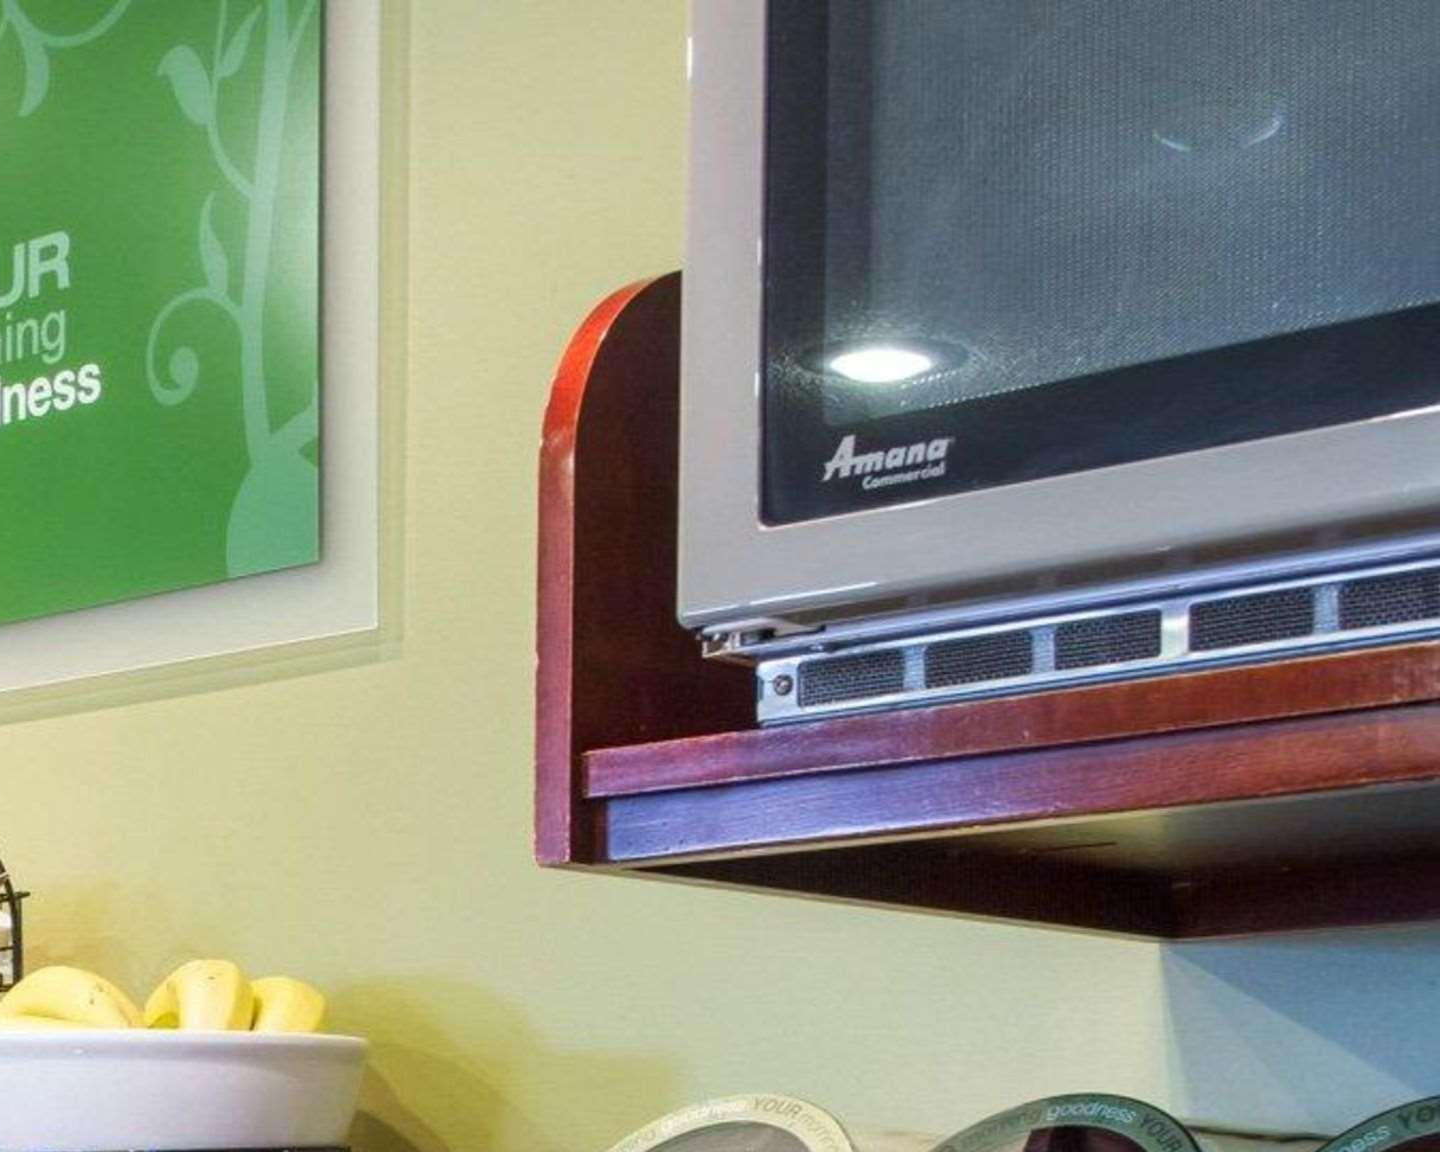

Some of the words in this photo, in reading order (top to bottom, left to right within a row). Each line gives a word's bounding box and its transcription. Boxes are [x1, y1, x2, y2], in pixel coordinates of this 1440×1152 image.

[821, 434, 952, 482] Amana
[861, 461, 946, 490] Commercial
[751, 1096, 803, 1119] YOUR
[1046, 1103, 1137, 1124] goodness
